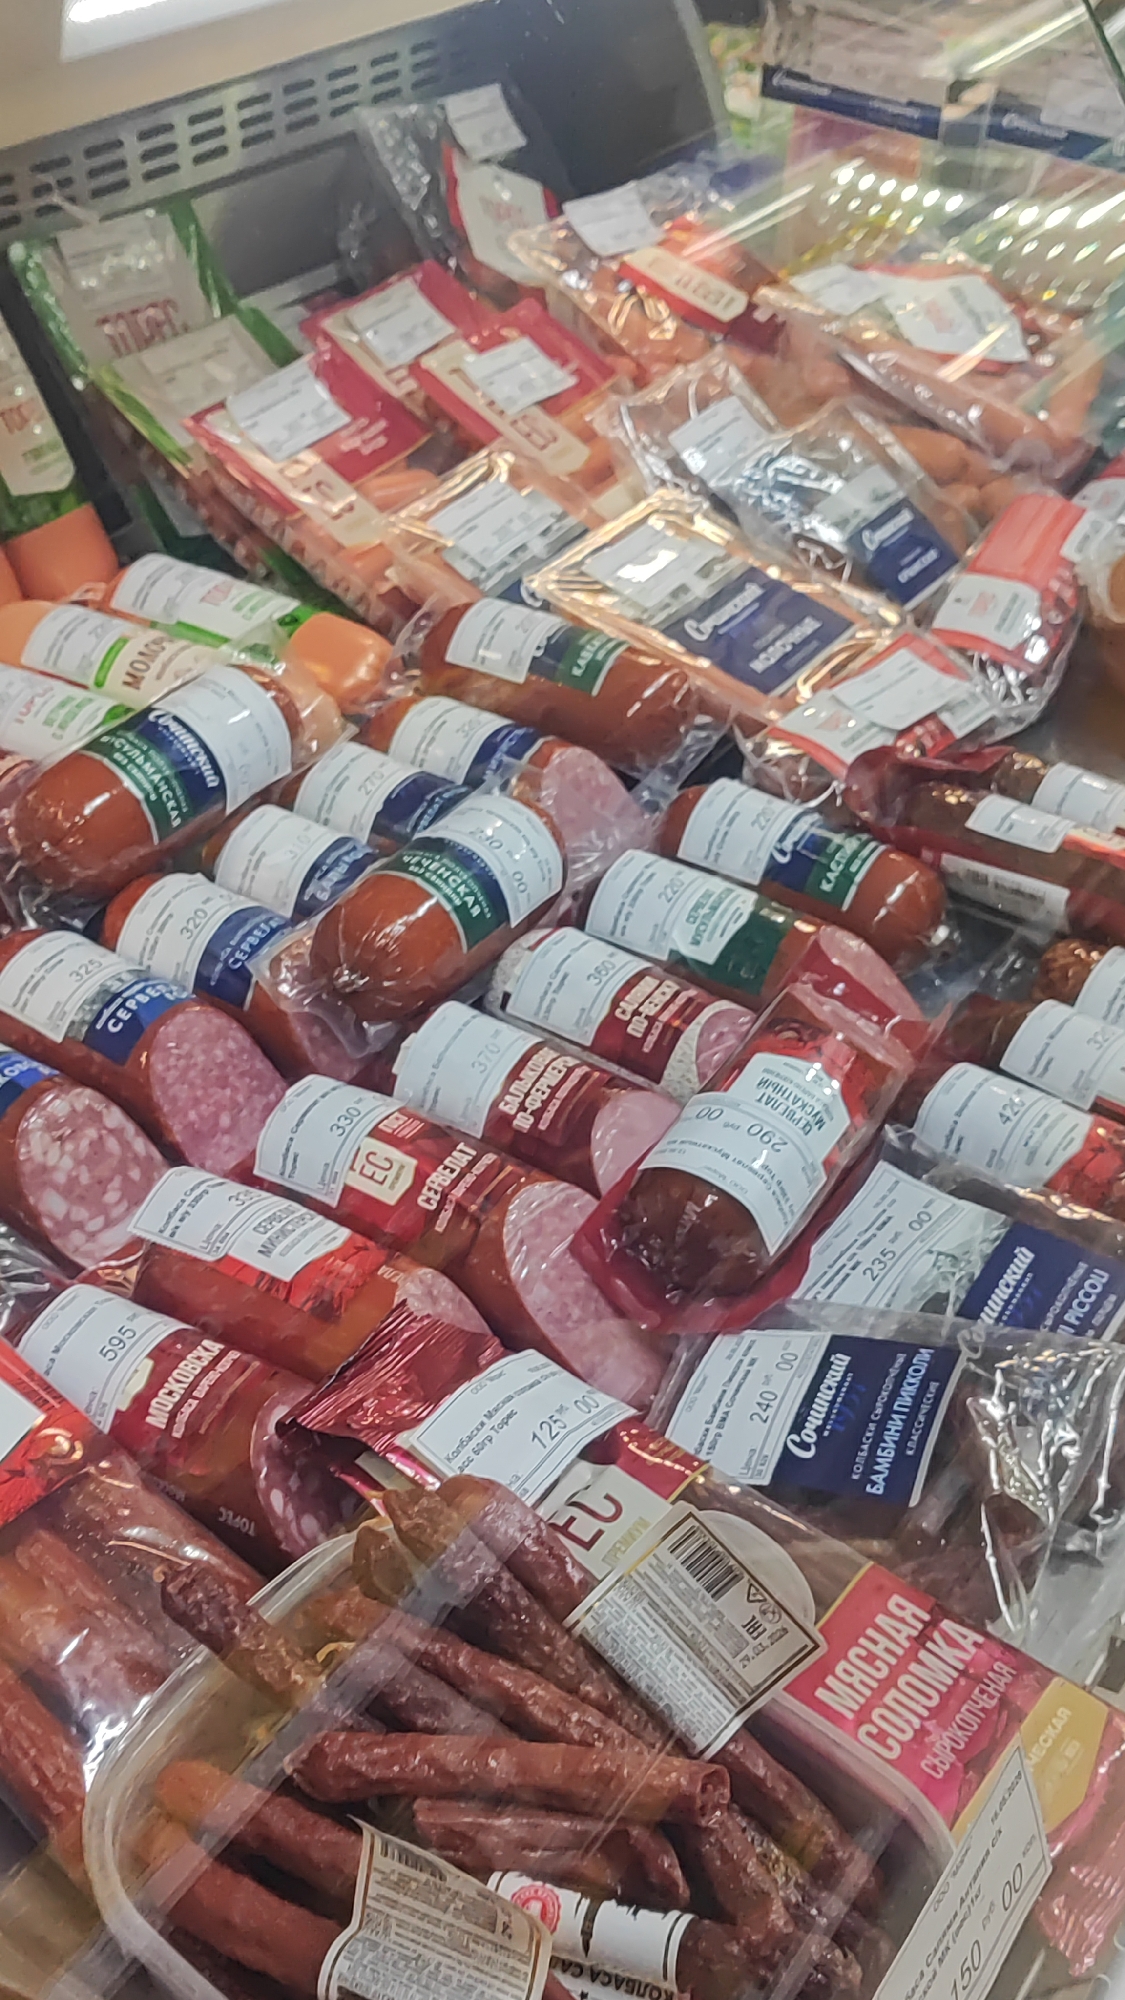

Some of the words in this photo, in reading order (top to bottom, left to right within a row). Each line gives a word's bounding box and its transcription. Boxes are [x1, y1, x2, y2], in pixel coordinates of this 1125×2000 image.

[329, 1105, 362, 1138] 330
[694, 1105, 725, 1122] 00
[756, 1075, 828, 1132] МУСКАТНЫЙ
[745, 1120, 790, 1154] 290
[416, 1141, 478, 1211] СЕРВЕЛАТ
[861, 1248, 897, 1281] 235
[908, 1210, 933, 1233] 00
[98, 1324, 138, 1363] 595
[749, 1389, 779, 1425] 240
[775, 1351, 799, 1372] 00
[786, 1352, 853, 1460] Сочинский
[443, 1419, 487, 1465] Колбаски
[488, 1407, 519, 1438] Торес
[530, 1413, 568, 1450] 125
[573, 1392, 601, 1415] 00
[865, 1419, 905, 1496] БАМБИНИ
[893, 1348, 936, 1421] ПИККОЛИ
[814, 1593, 931, 1721] МЯСНАЯ
[857, 1618, 986, 1761] СОЛОМКА
[919, 1660, 1018, 1780] СЫРОКОПЧЕНАЯ
[1027, 1706, 1073, 1770] ЧЕСКАЯ
[1000, 1861, 1024, 1913] 00
